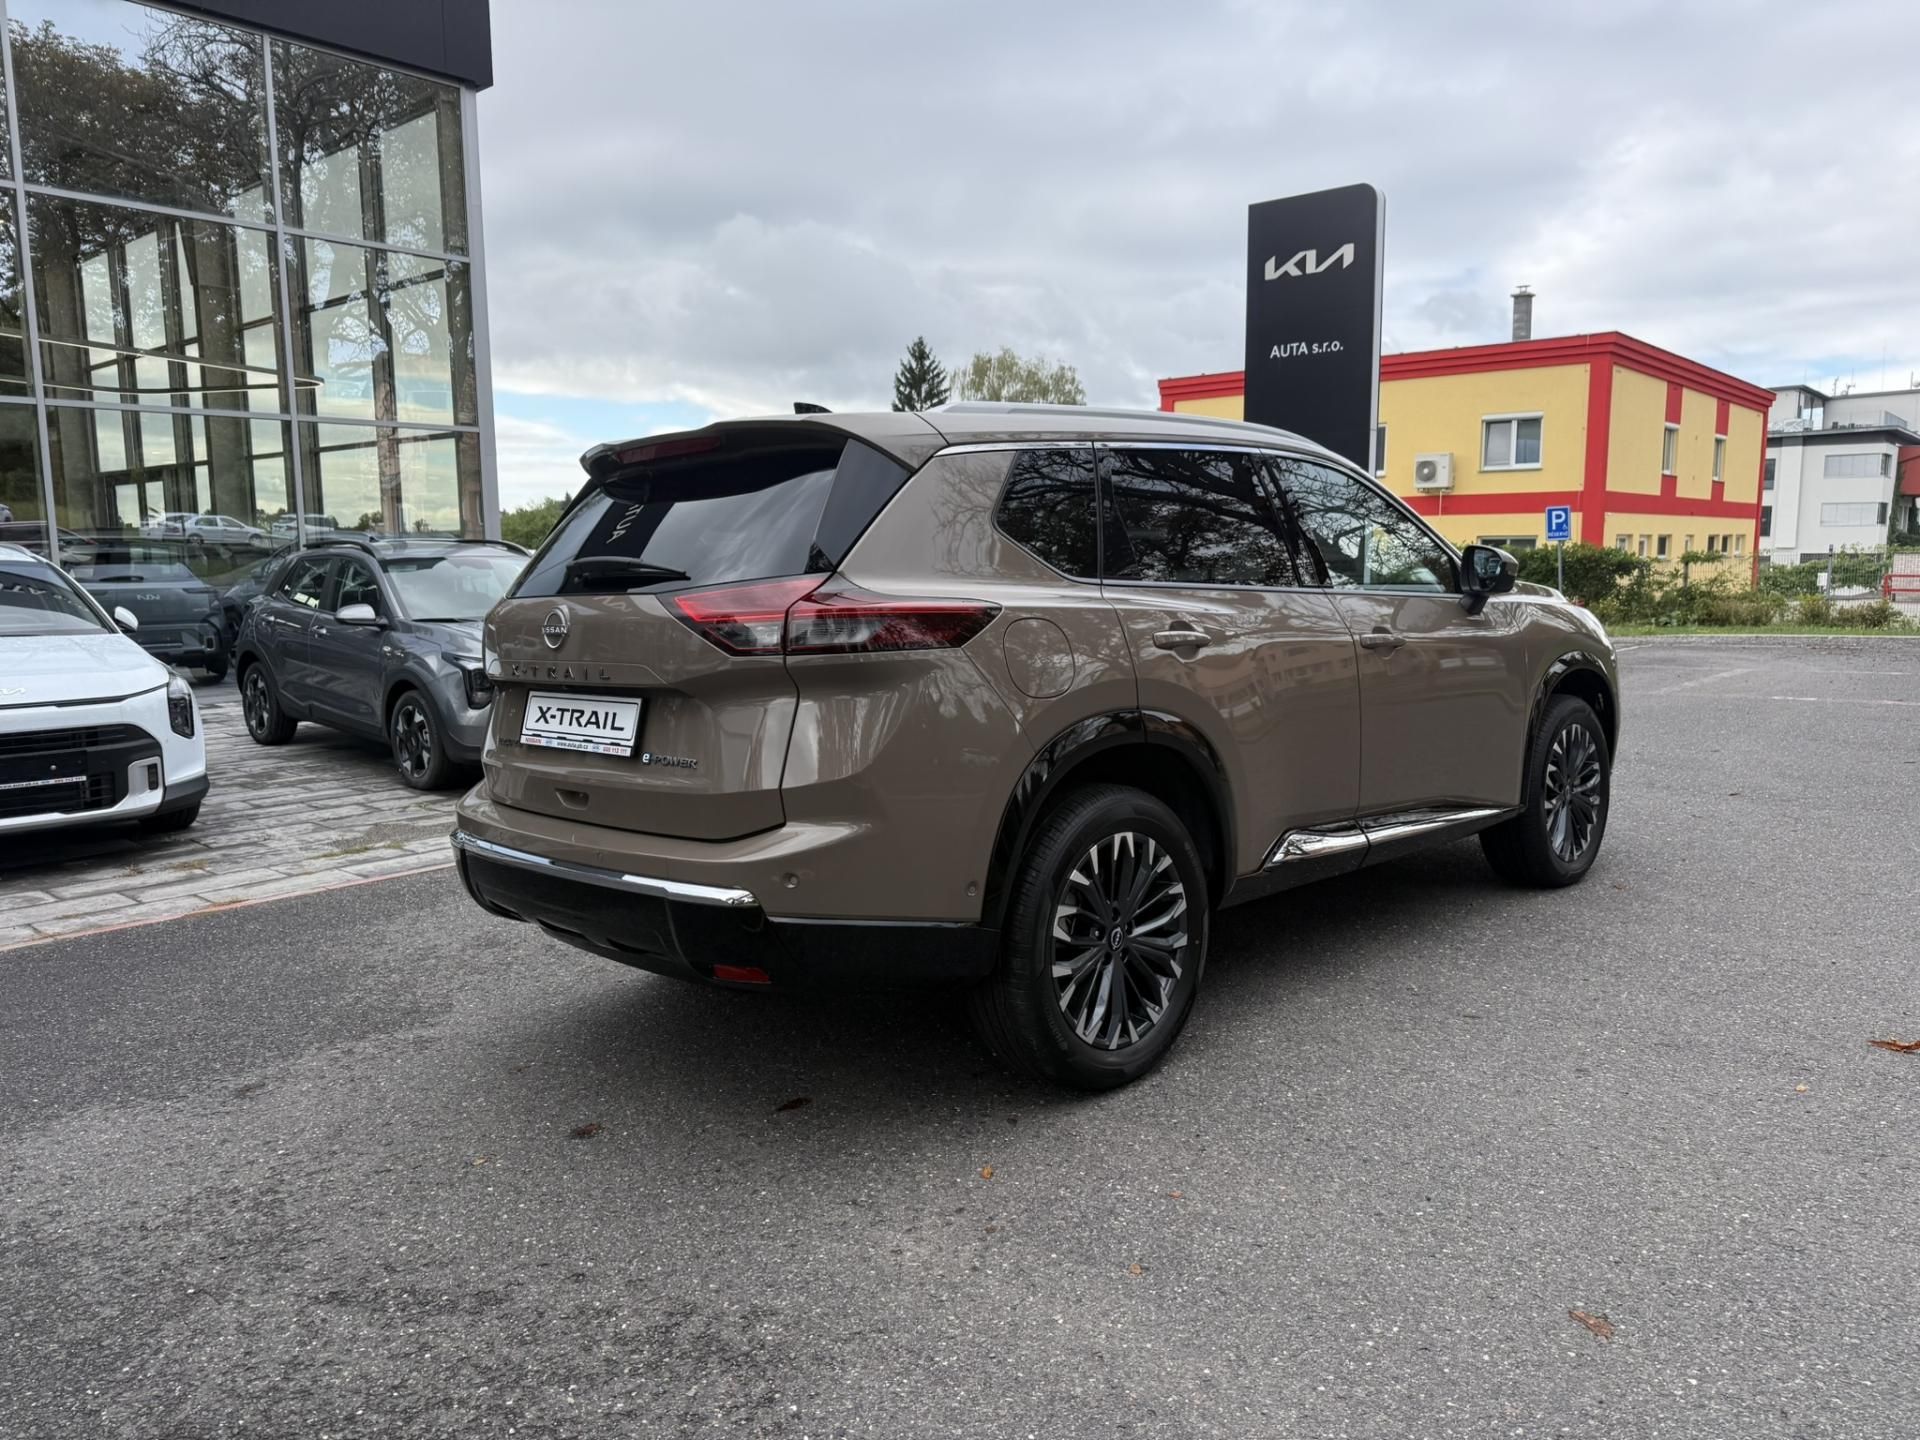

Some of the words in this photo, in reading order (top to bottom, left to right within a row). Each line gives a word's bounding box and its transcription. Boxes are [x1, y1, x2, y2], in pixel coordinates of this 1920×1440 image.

[1264, 242, 1355, 281] KIA
[1270, 342, 1308, 359] AUTA
[1311, 340, 1344, 354] s.r.o.
[1551, 510, 1566, 530] P
[535, 706, 625, 732] X-TRAIL
